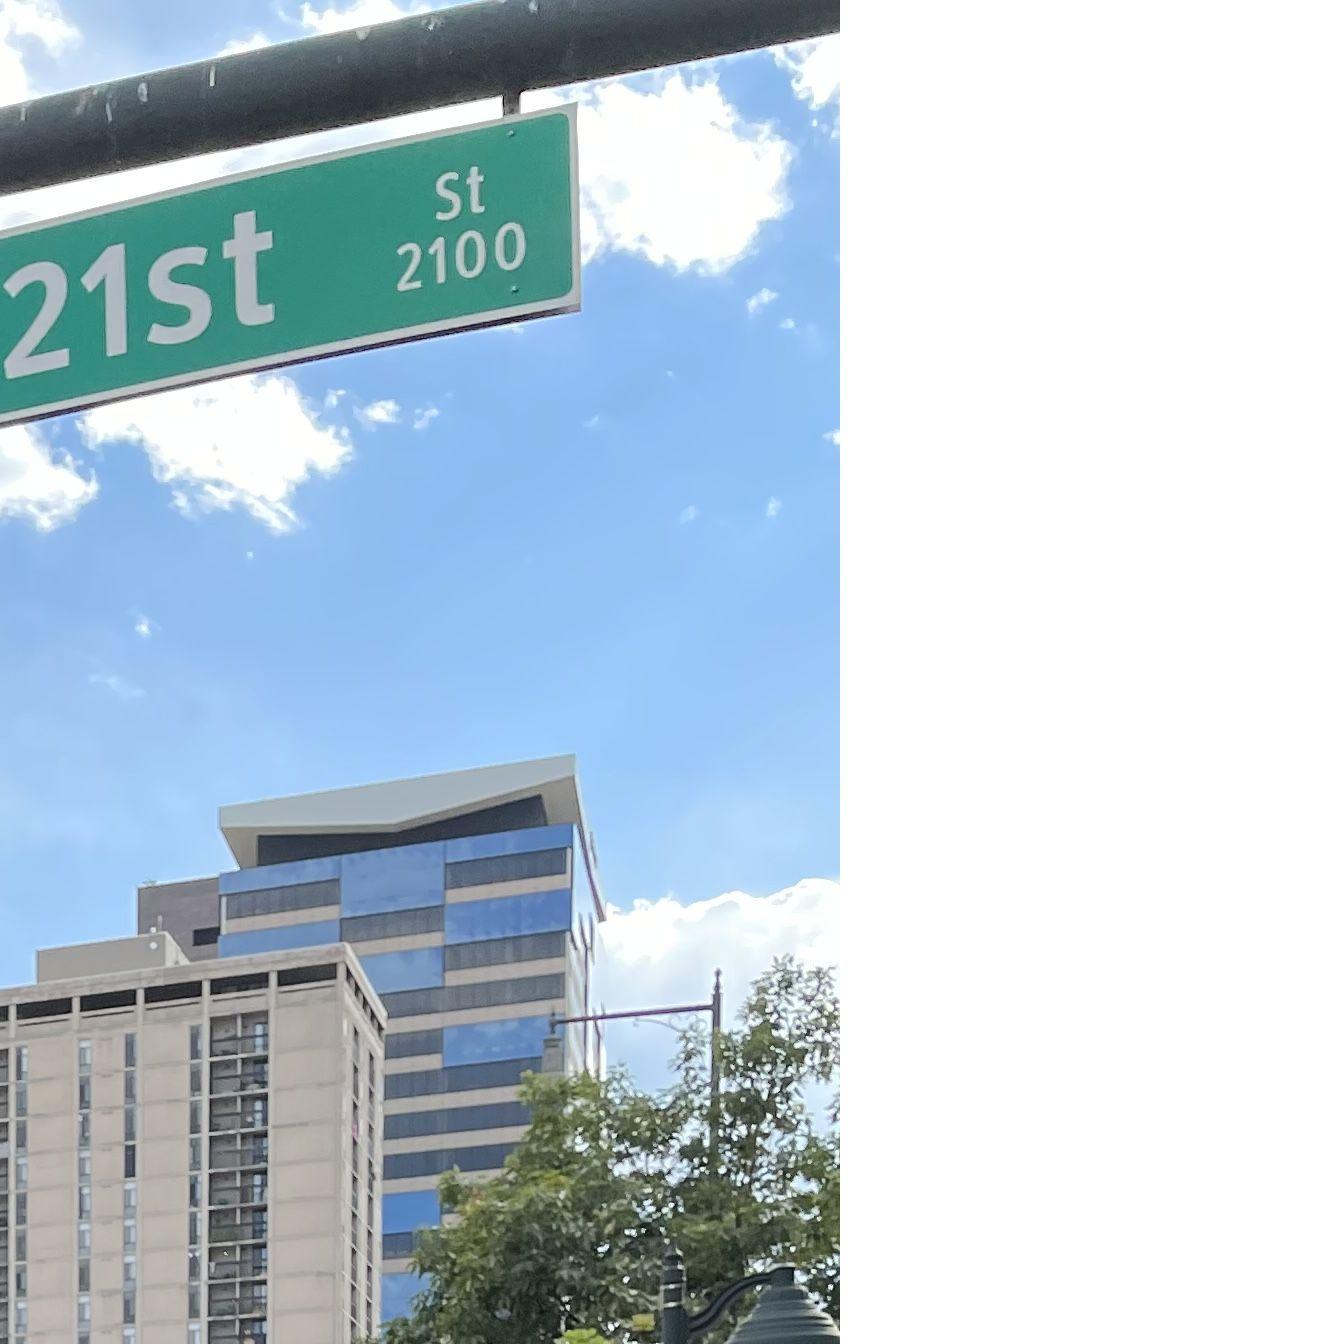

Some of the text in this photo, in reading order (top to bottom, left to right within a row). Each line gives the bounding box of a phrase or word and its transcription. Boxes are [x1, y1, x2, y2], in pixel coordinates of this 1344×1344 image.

[434, 165, 486, 223] St
[396, 221, 527, 293] 2100
[1, 209, 276, 381] 21st
